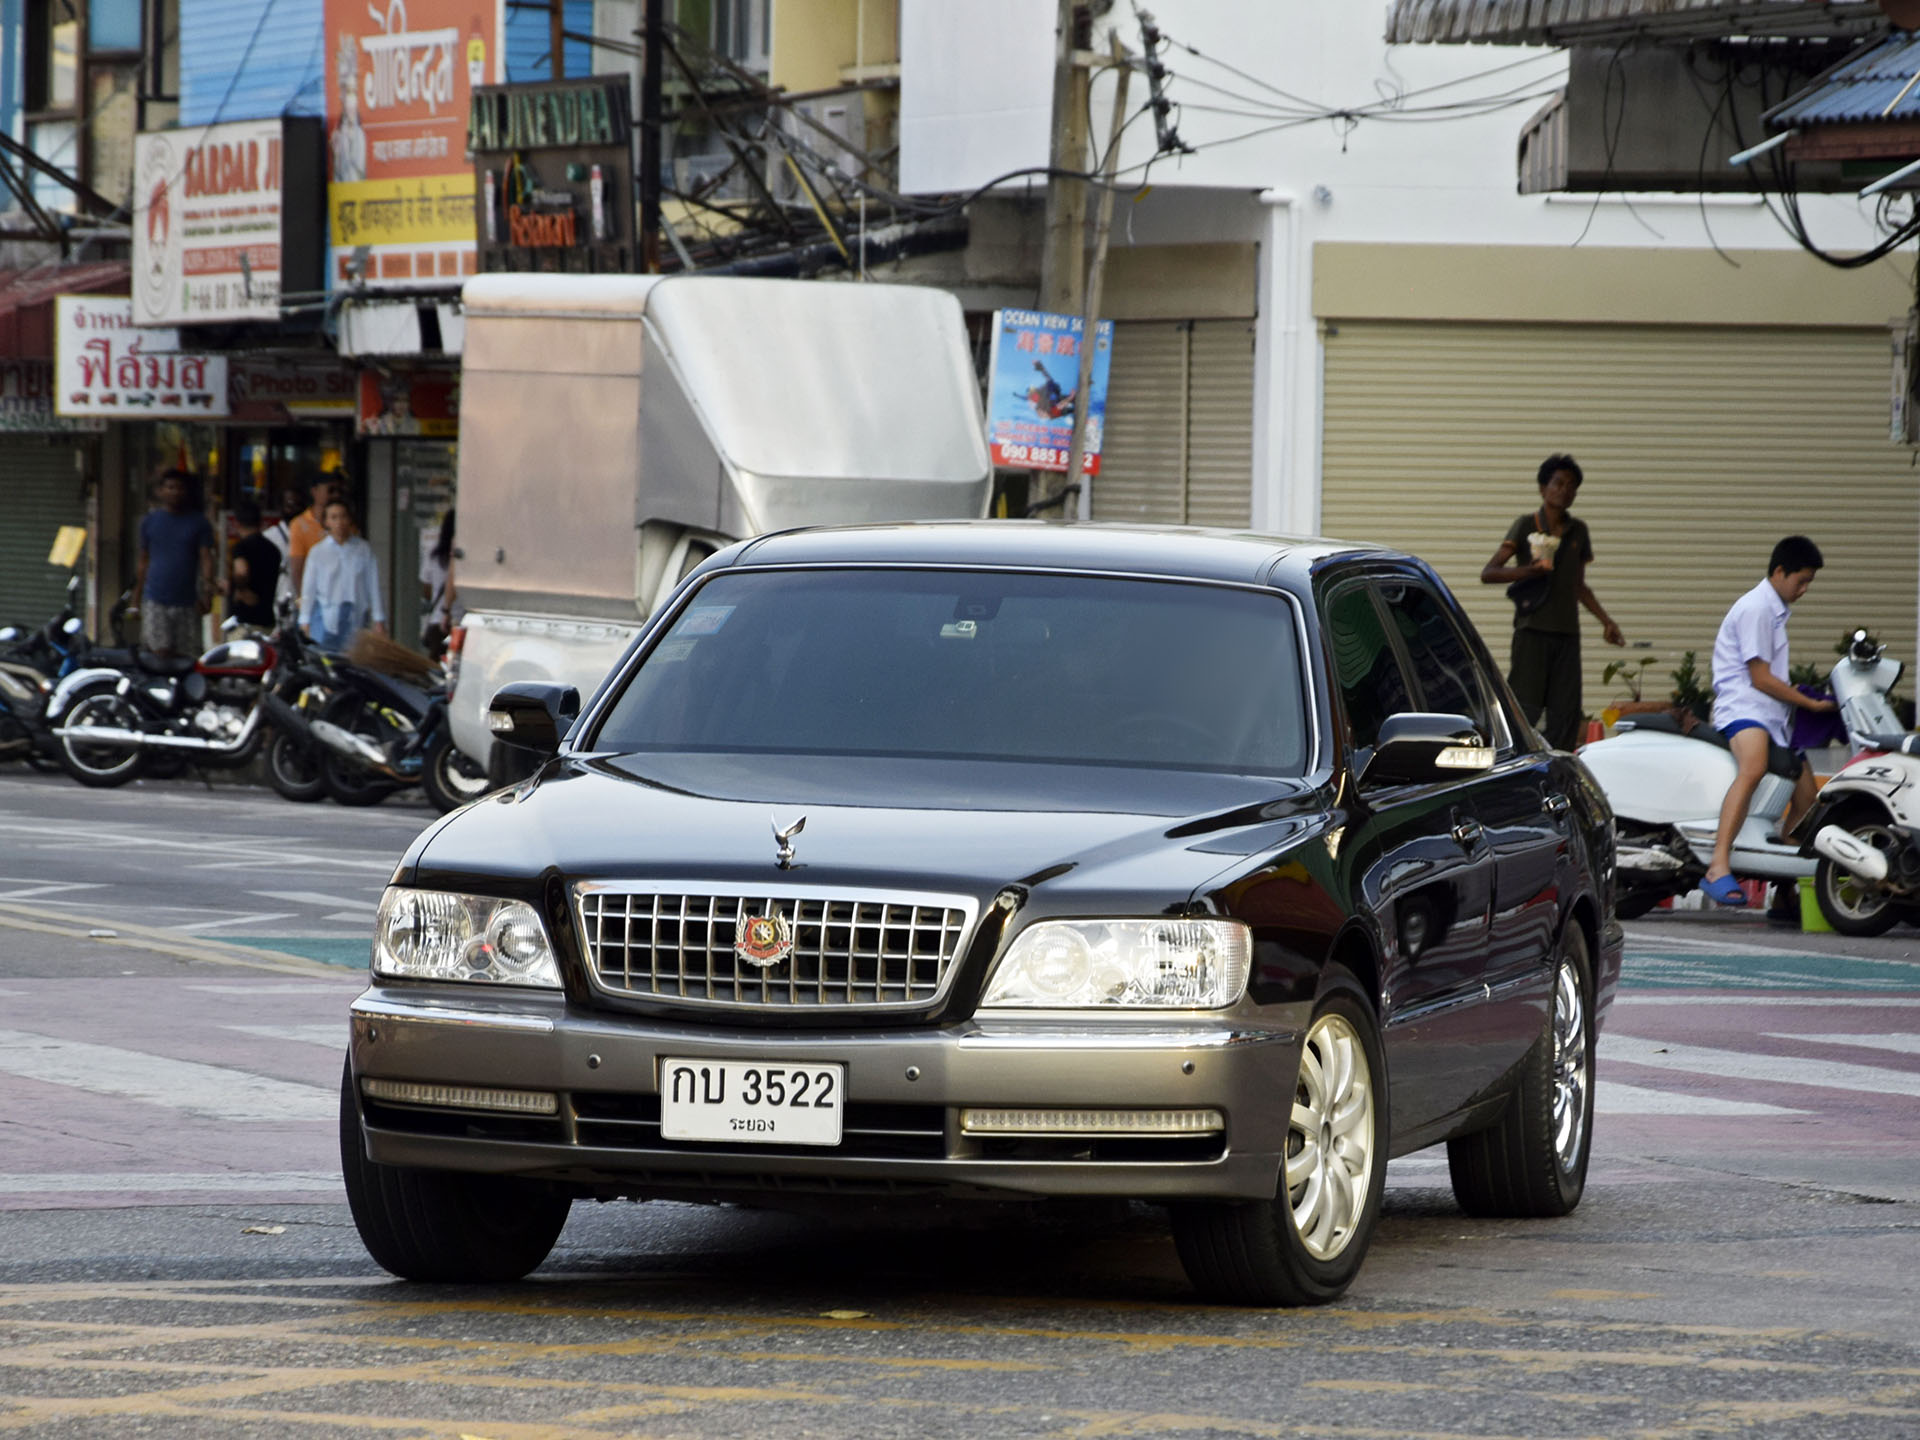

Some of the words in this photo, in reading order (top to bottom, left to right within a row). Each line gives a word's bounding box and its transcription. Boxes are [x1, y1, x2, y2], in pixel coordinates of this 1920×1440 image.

[184, 140, 259, 198] SARDAR
[1005, 310, 1039, 327] OCEAN
[1043, 315, 1068, 330] VIEW
[250, 372, 318, 395] Photo
[1001, 443, 1027, 459] 090
[1030, 446, 1057, 463] 885
[673, 1067, 725, 1104] กบ
[742, 1069, 834, 1108] 3522
[729, 1118, 775, 1132] ระยอง
